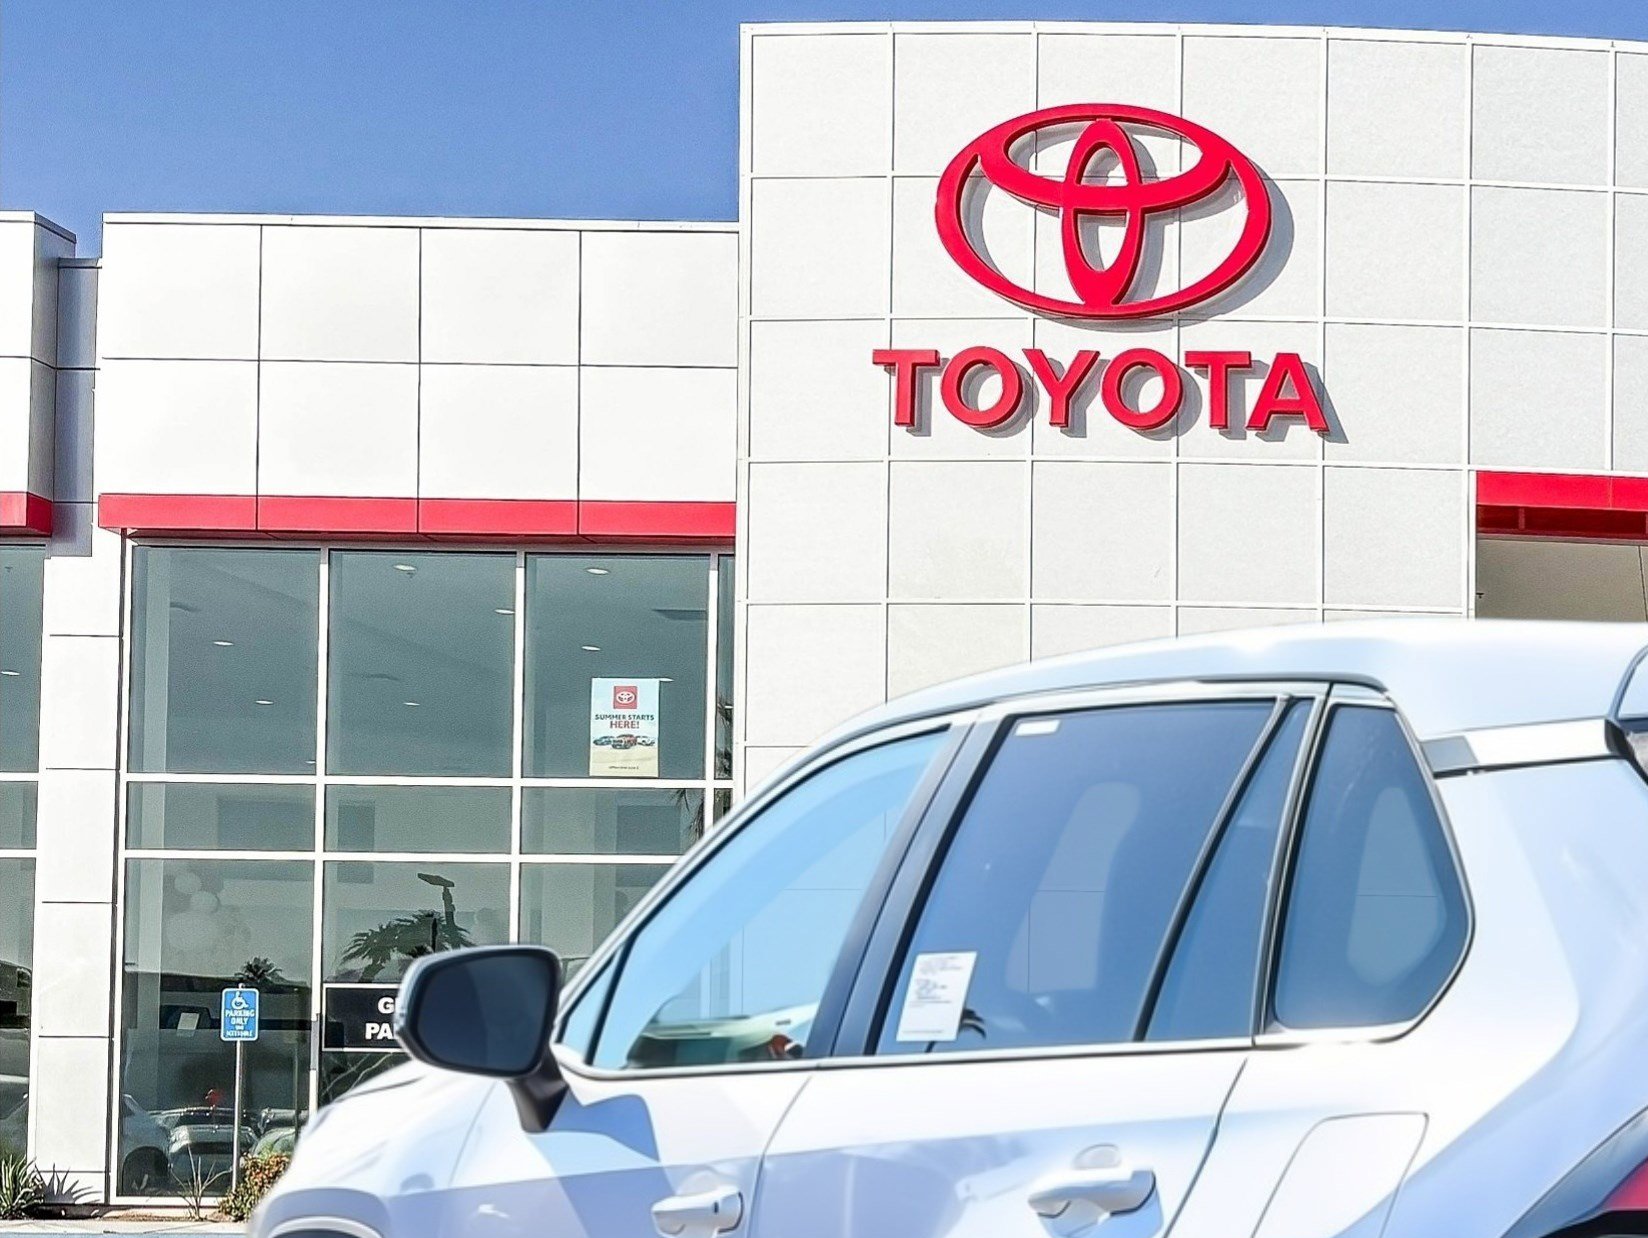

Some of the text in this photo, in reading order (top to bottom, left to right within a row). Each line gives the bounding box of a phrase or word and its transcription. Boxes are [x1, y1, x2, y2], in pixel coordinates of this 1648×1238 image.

[872, 346, 1330, 434] TOYOTA
[610, 720, 640, 729] HERE!
[225, 1009, 255, 1017] PARKING
